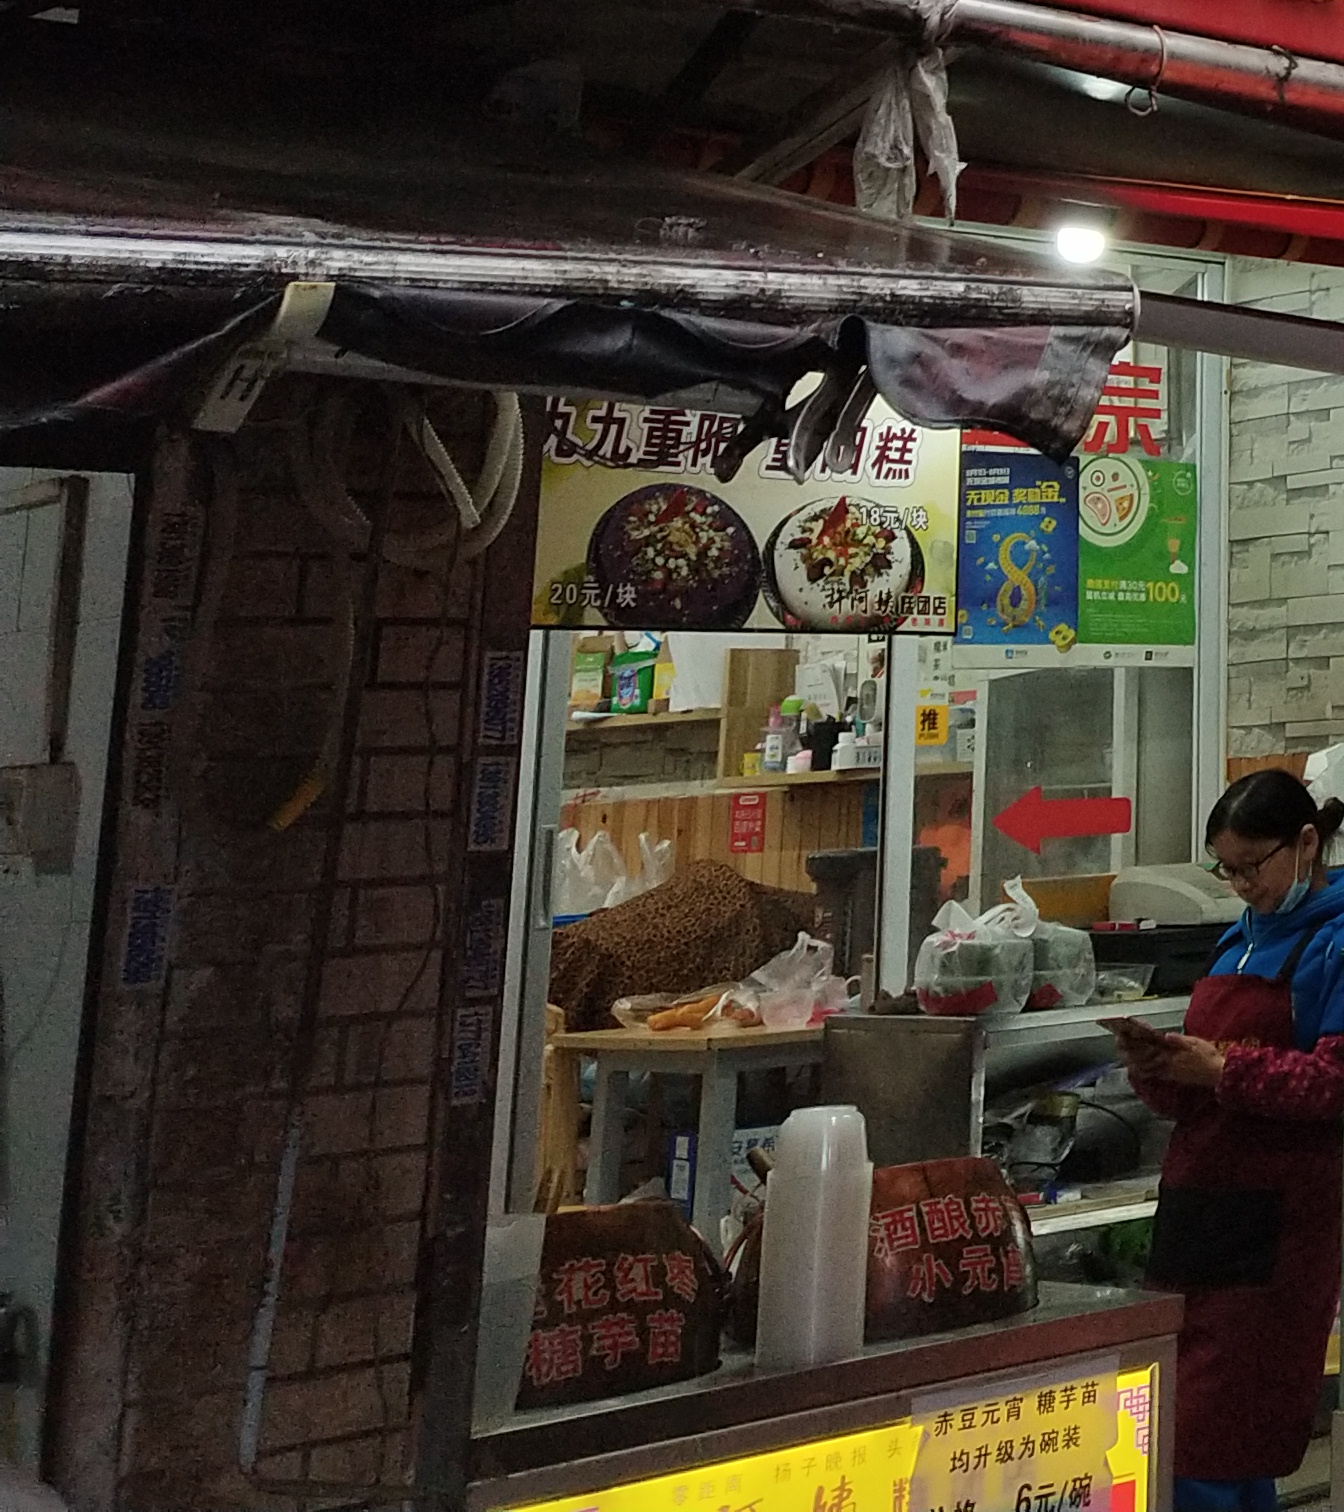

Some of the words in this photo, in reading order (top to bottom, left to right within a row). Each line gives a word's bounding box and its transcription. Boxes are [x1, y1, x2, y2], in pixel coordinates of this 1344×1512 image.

[859, 505, 930, 531] 18元/块
[549, 580, 638, 609] 20元/块
[920, 708, 939, 731] 推
[871, 1192, 1018, 1262] 酒酿赤
[534, 1251, 700, 1319] 花红枣
[527, 1309, 687, 1386] 糖芋苗
[933, 1395, 1024, 1437] 赤豆元宵
[1036, 1381, 1099, 1416] 糖芋苗
[774, 1445, 868, 1484] 扬子晚报
[949, 1424, 1082, 1474] 均升级为碗装
